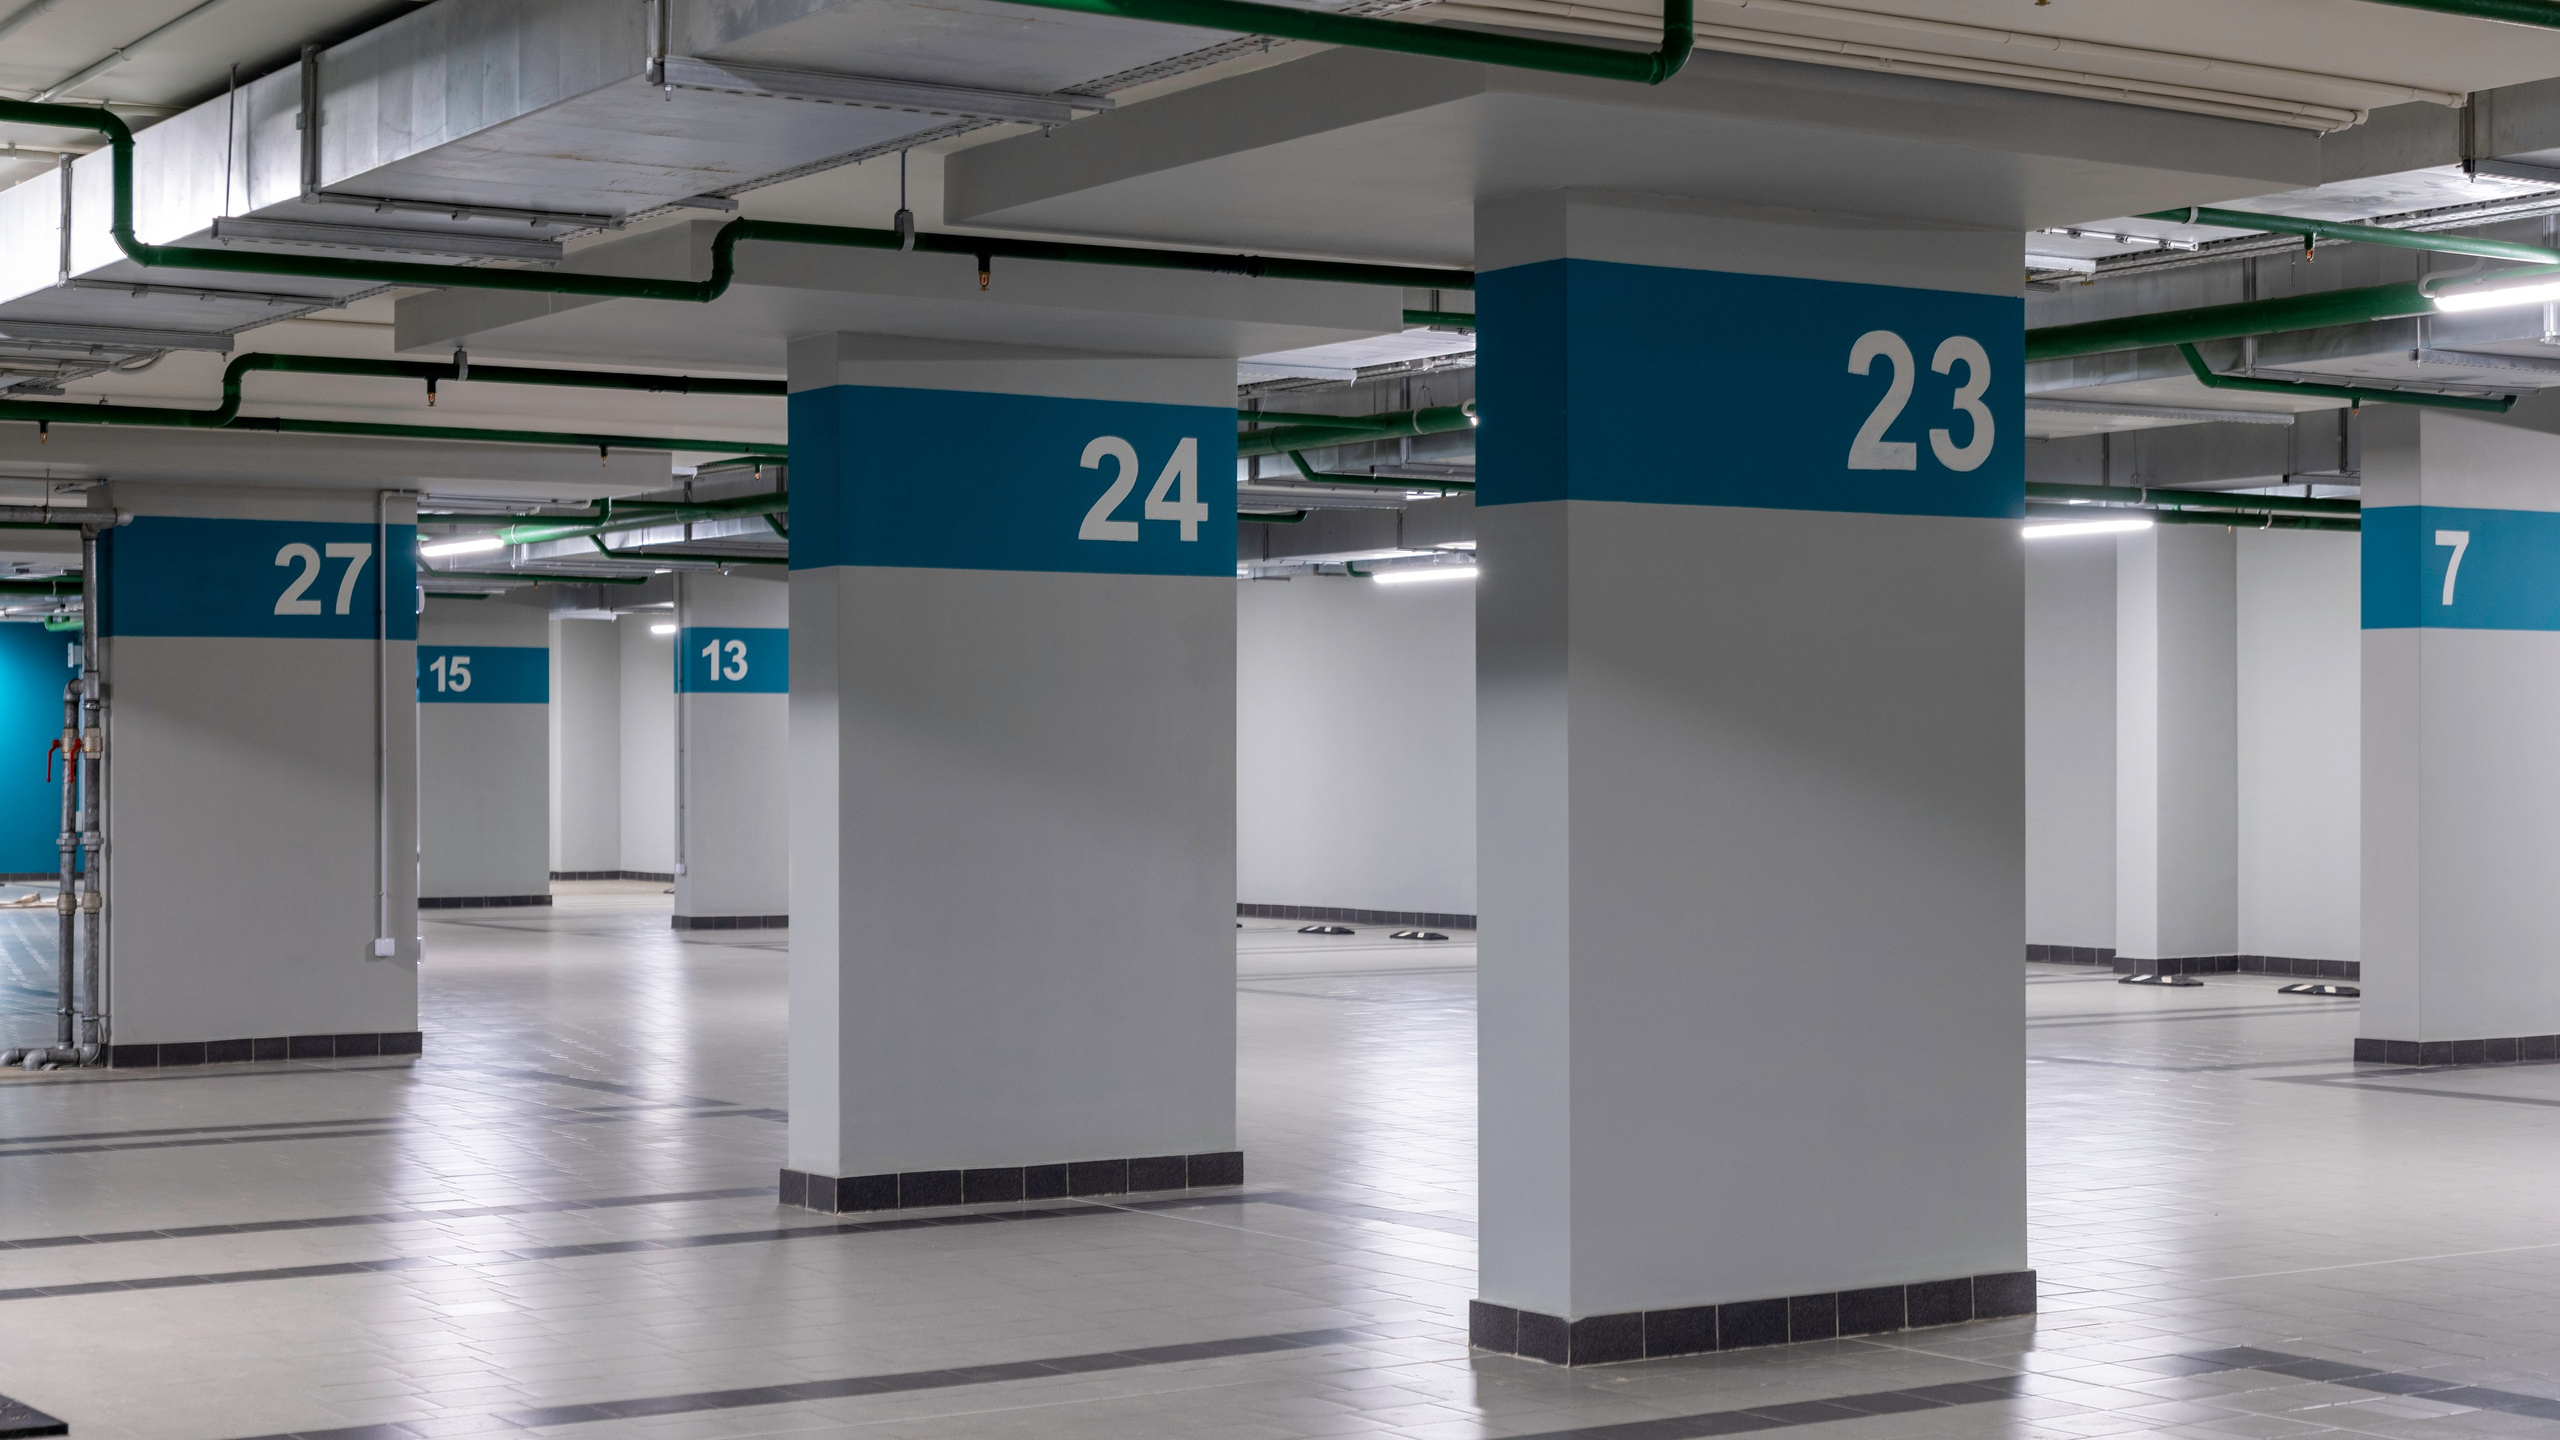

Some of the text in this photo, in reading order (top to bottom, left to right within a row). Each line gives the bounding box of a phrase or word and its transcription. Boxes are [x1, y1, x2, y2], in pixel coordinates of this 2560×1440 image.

[1848, 330, 1994, 471] 23
[1078, 436, 1208, 541] 24
[274, 543, 371, 615] 27
[2435, 530, 2469, 605] 7
[430, 656, 471, 692] 15
[701, 640, 748, 681] 13
